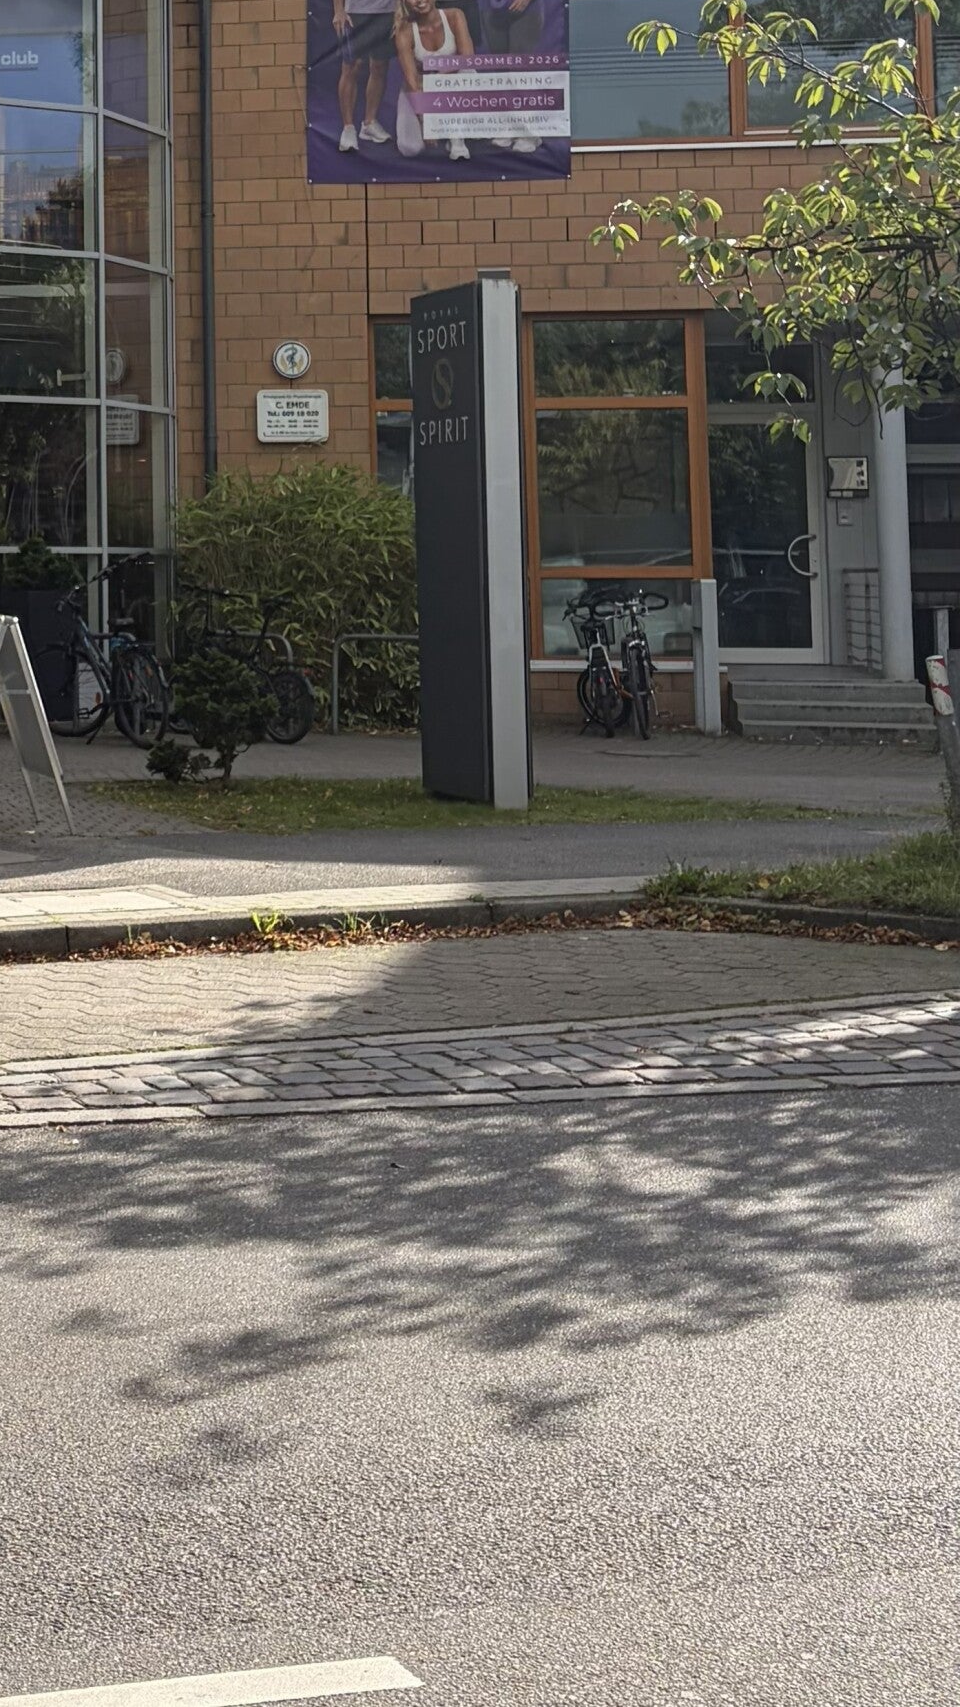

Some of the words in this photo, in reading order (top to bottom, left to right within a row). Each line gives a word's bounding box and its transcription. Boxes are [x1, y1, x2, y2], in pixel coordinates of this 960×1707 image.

[428, 57, 460, 67] DEIN
[466, 56, 522, 66] SOMMER
[528, 55, 560, 64] 2026
[434, 76, 553, 88] GRATIS-TRAINING
[432, 97, 442, 108] 4
[446, 95, 508, 108] Wochen
[512, 93, 556, 109] gratis
[438, 117, 485, 125] SUPERIOR
[487, 115, 550, 125] ALL-INKLUSIV
[417, 320, 467, 354] SPORT
[419, 415, 468, 446] SPIRIT
